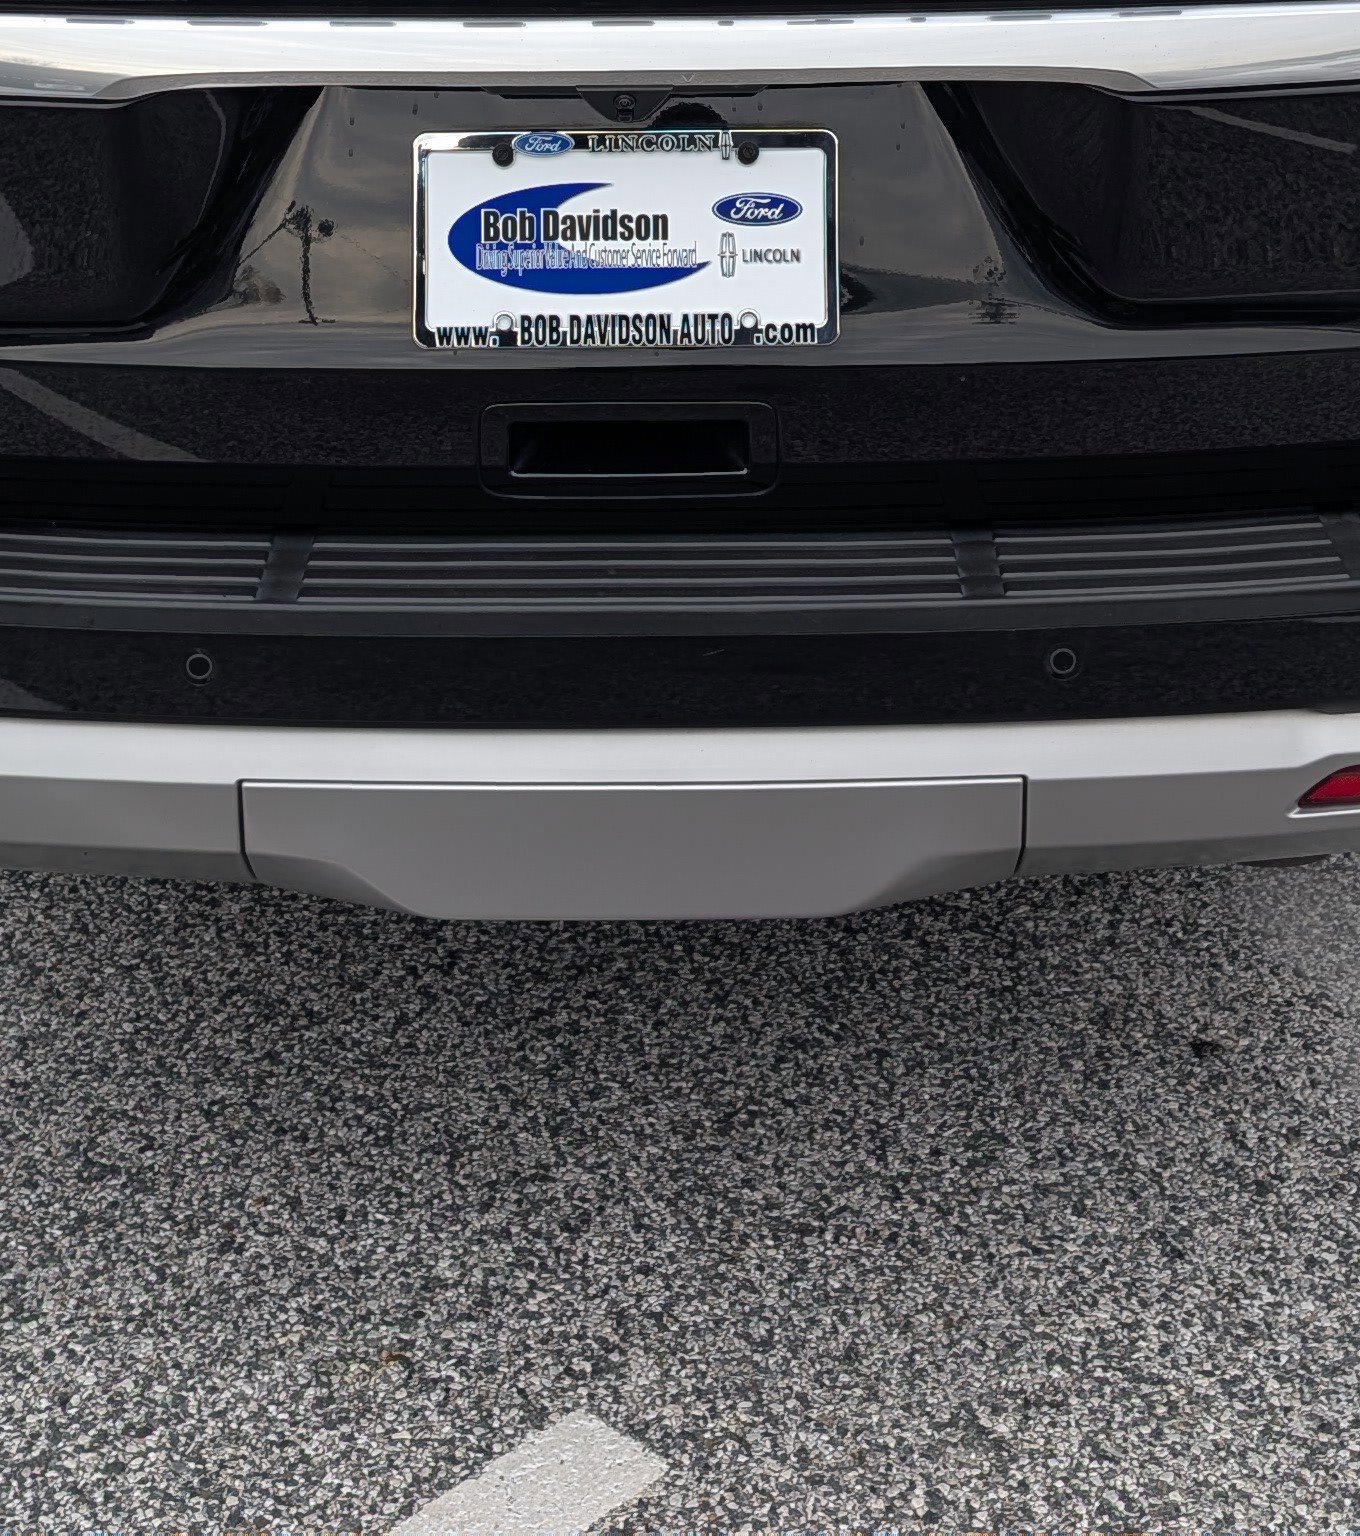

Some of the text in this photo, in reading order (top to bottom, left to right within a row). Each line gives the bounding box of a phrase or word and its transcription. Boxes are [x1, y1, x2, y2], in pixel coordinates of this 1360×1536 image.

[524, 134, 716, 154] Ford LINCOLN
[730, 196, 784, 220] Ford
[482, 209, 669, 242] Bob Davidson
[589, 241, 630, 269] Customer
[630, 241, 661, 269] Service
[662, 241, 698, 269] Forward
[741, 247, 801, 264] LINCOLN
[517, 313, 564, 347] BOB
[567, 312, 673, 347] DAVIDSON
[678, 311, 736, 346] AUTO
